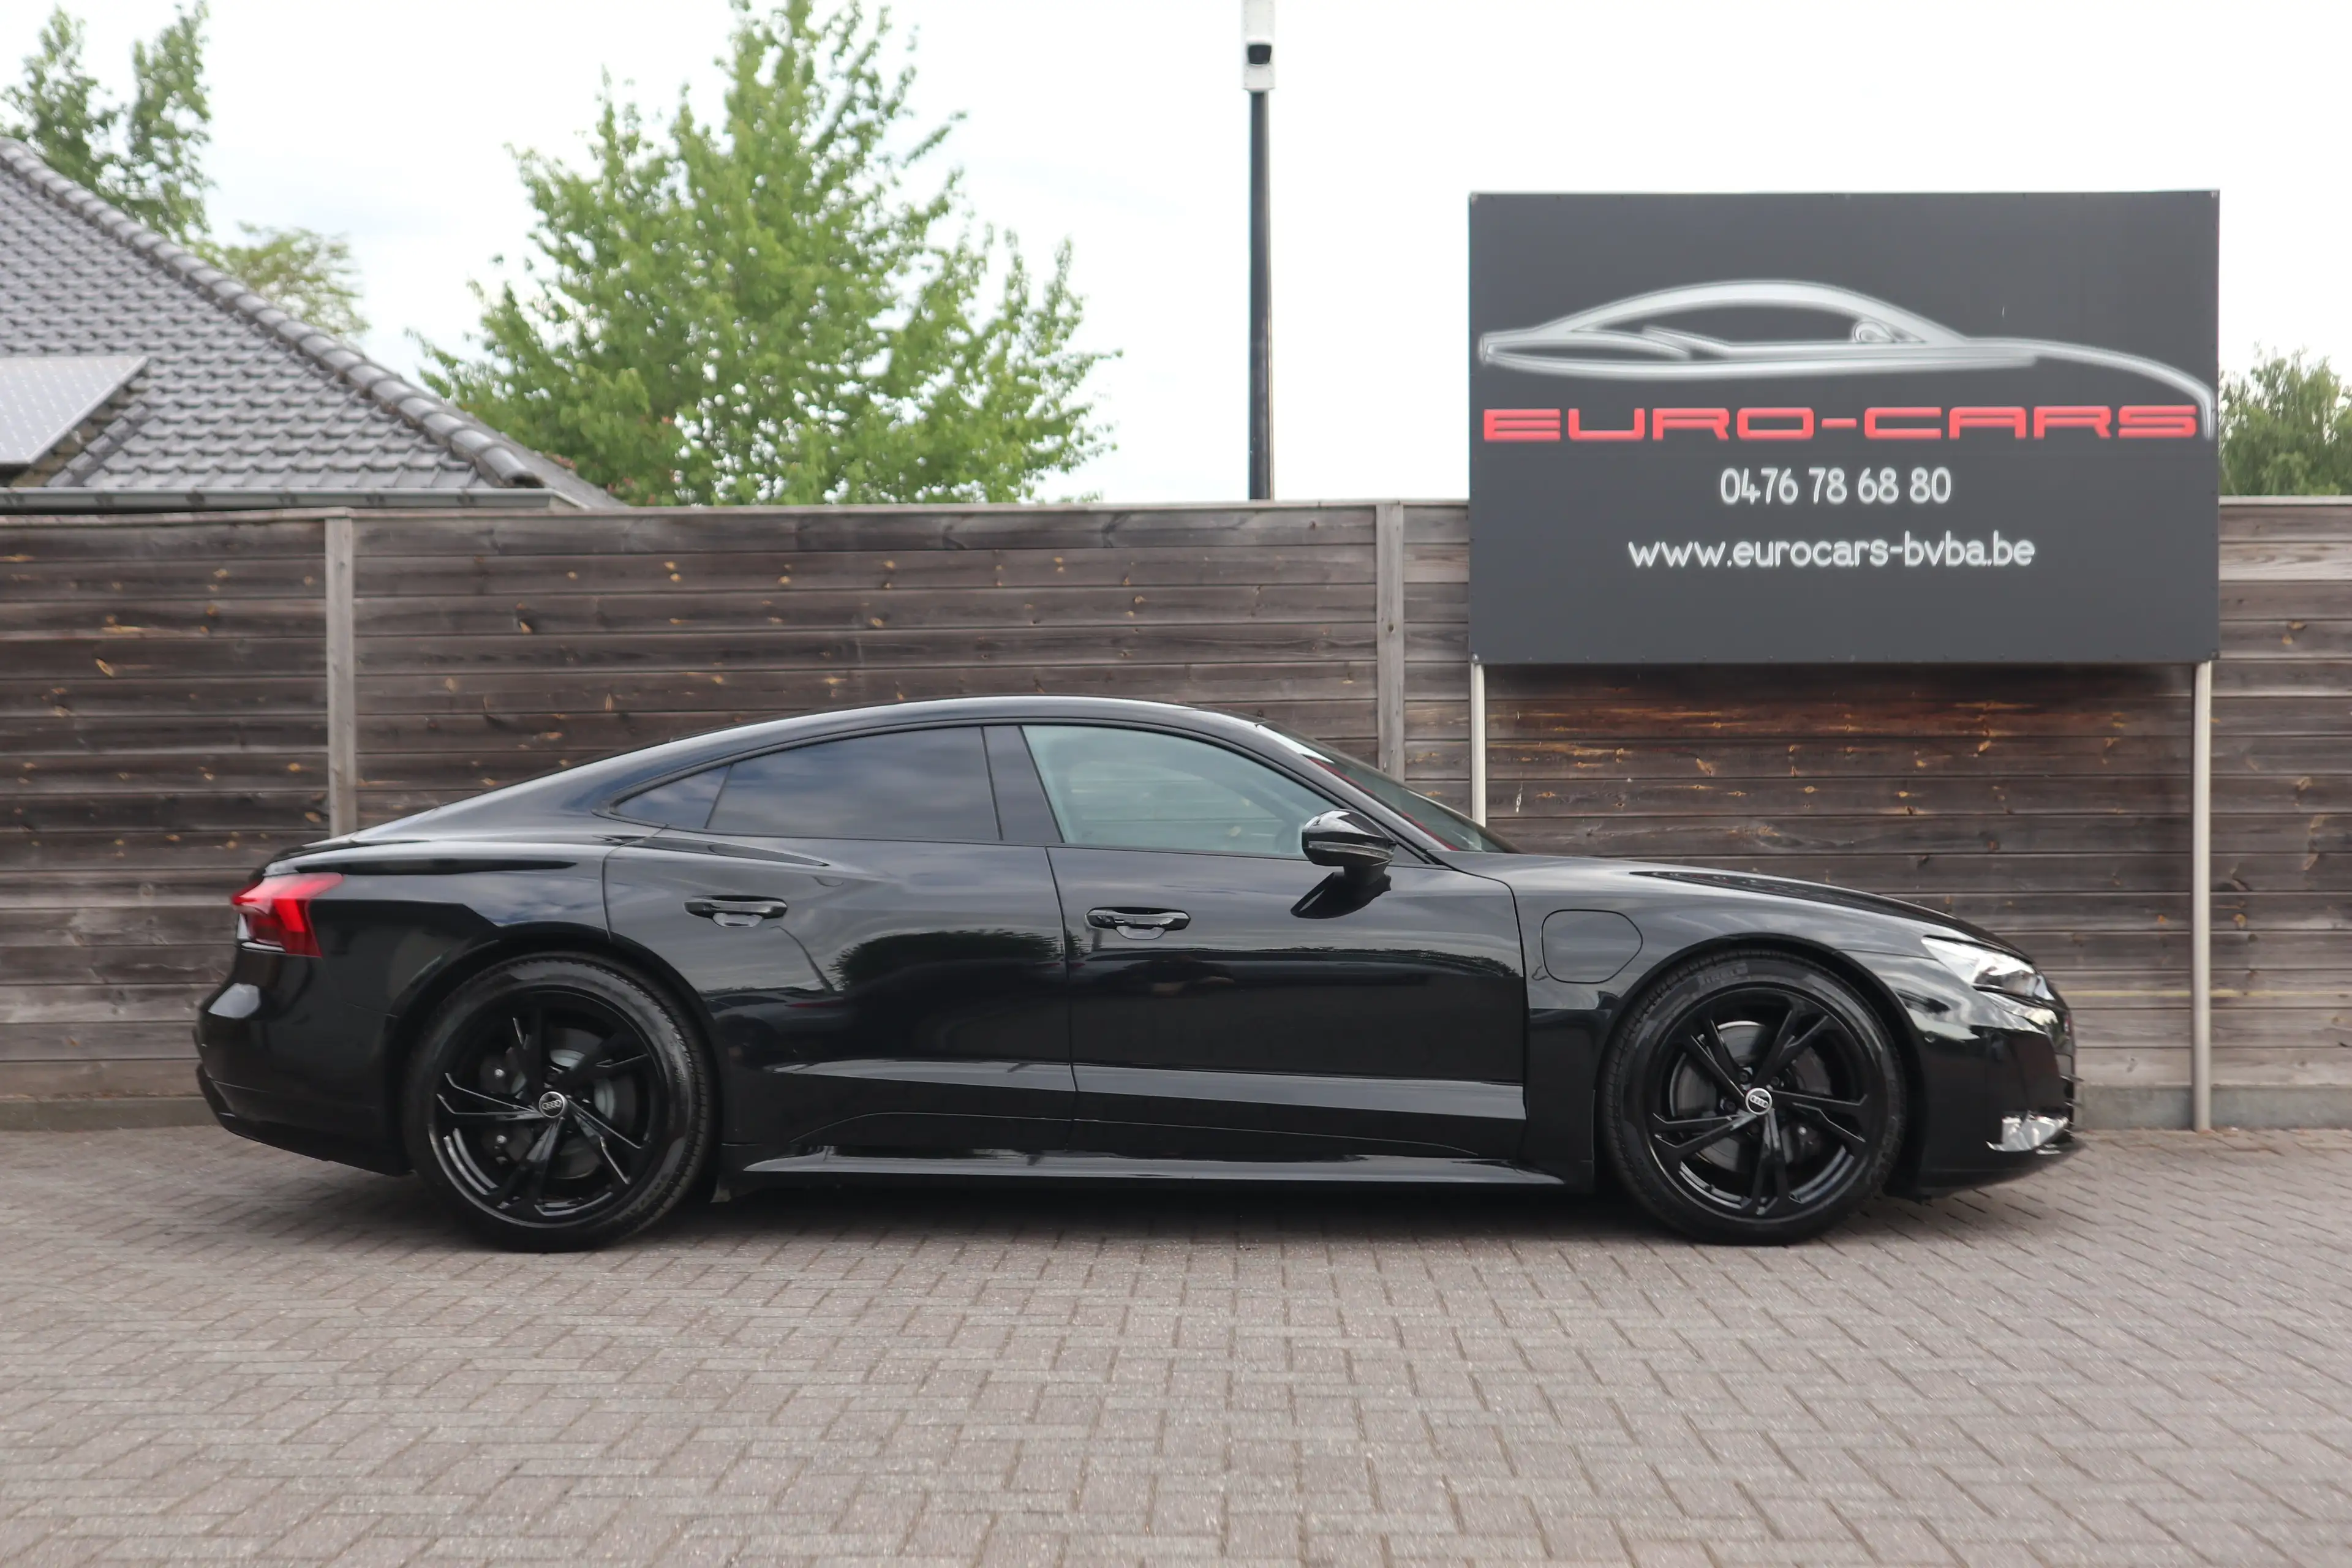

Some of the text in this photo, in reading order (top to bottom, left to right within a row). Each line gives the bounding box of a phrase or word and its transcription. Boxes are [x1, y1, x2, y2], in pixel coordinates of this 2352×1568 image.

[1483, 405, 2197, 440] EURO-CARS
[1720, 466, 1951, 505] 0476 78 68 80
[1627, 529, 2036, 568] www.eurocars-bvba.be
